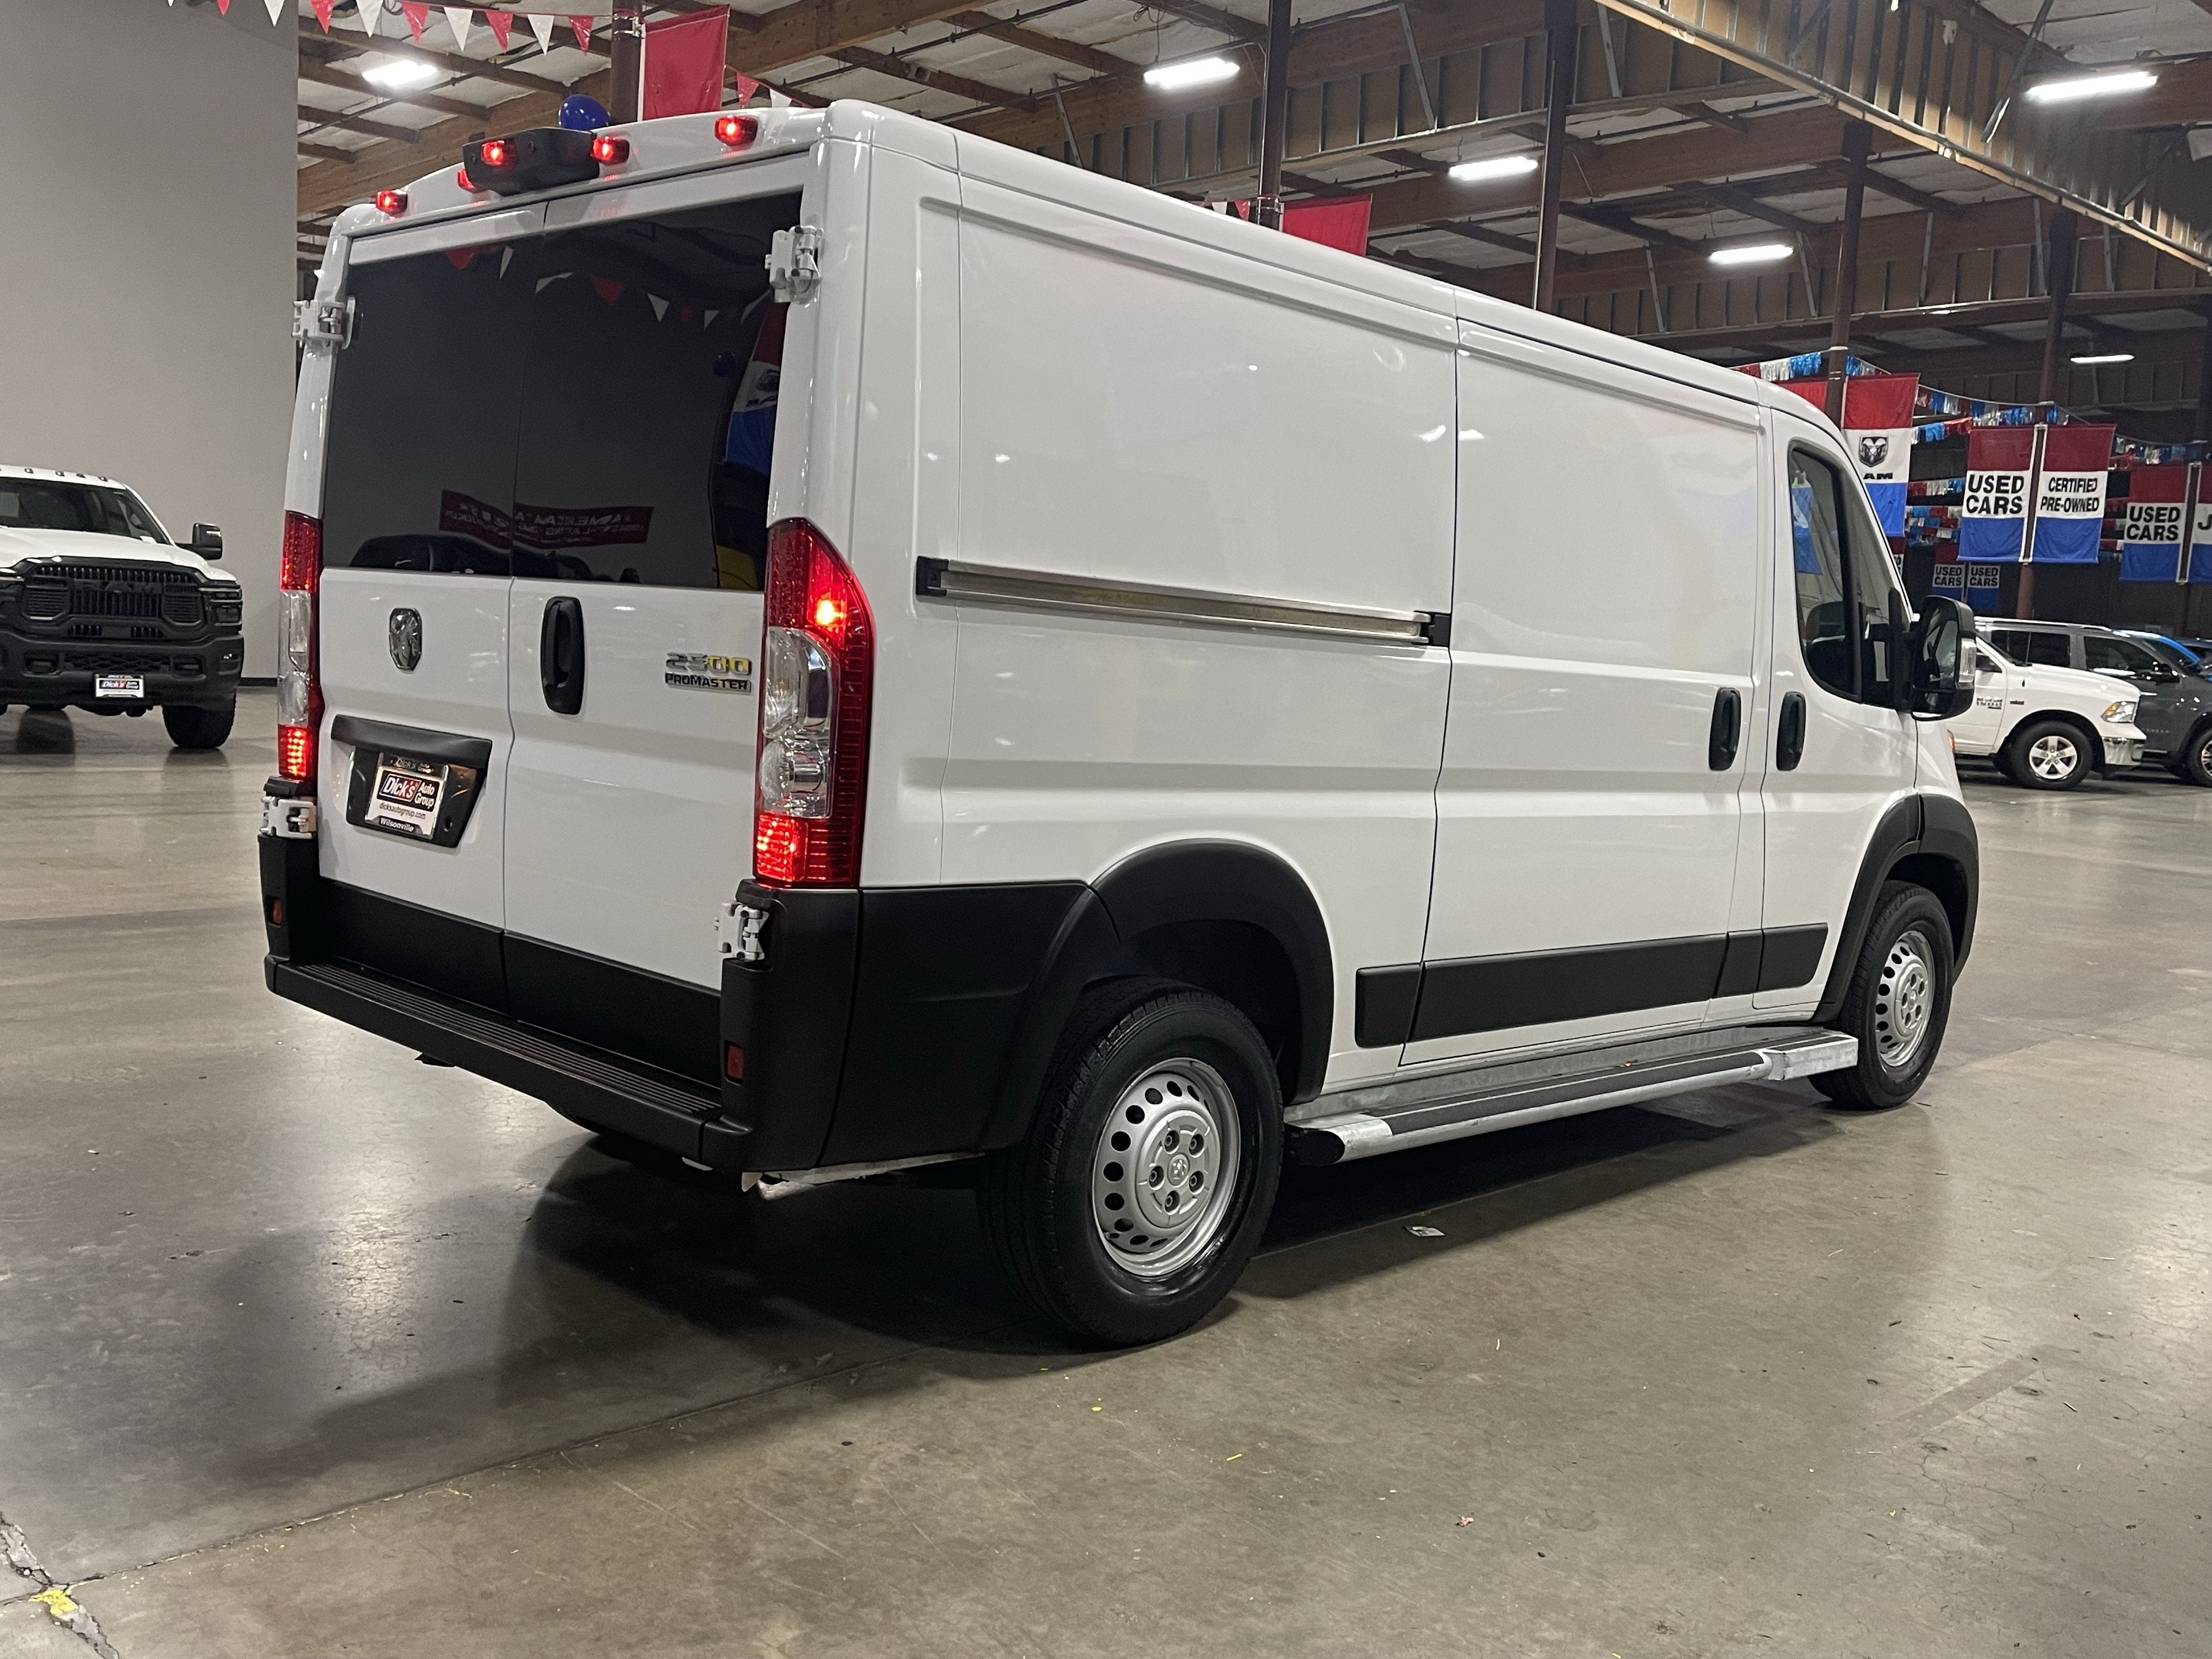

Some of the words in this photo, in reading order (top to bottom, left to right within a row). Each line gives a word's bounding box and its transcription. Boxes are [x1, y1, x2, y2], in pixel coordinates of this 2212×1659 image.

[1968, 474, 2024, 494] USED
[2048, 477, 2097, 493] CERTIFIED
[1966, 495, 2023, 514] CARS
[2040, 497, 2100, 512] PRE-OWNED
[2129, 506, 2180, 523] USED
[2126, 524, 2179, 541] CARS
[1936, 567, 1962, 576] USED
[1971, 567, 1998, 577] USED
[1934, 577, 1962, 586] CARS
[1970, 577, 1998, 586] CARS
[665, 652, 752, 675] 2500
[665, 673, 748, 690] PROMASTER
[382, 776, 416, 799] Dick's
[417, 782, 435, 795] Auto
[414, 792, 435, 809] Group
[379, 802, 426, 819] dicksautogroup.com
[380, 817, 414, 832] Wilsonville
